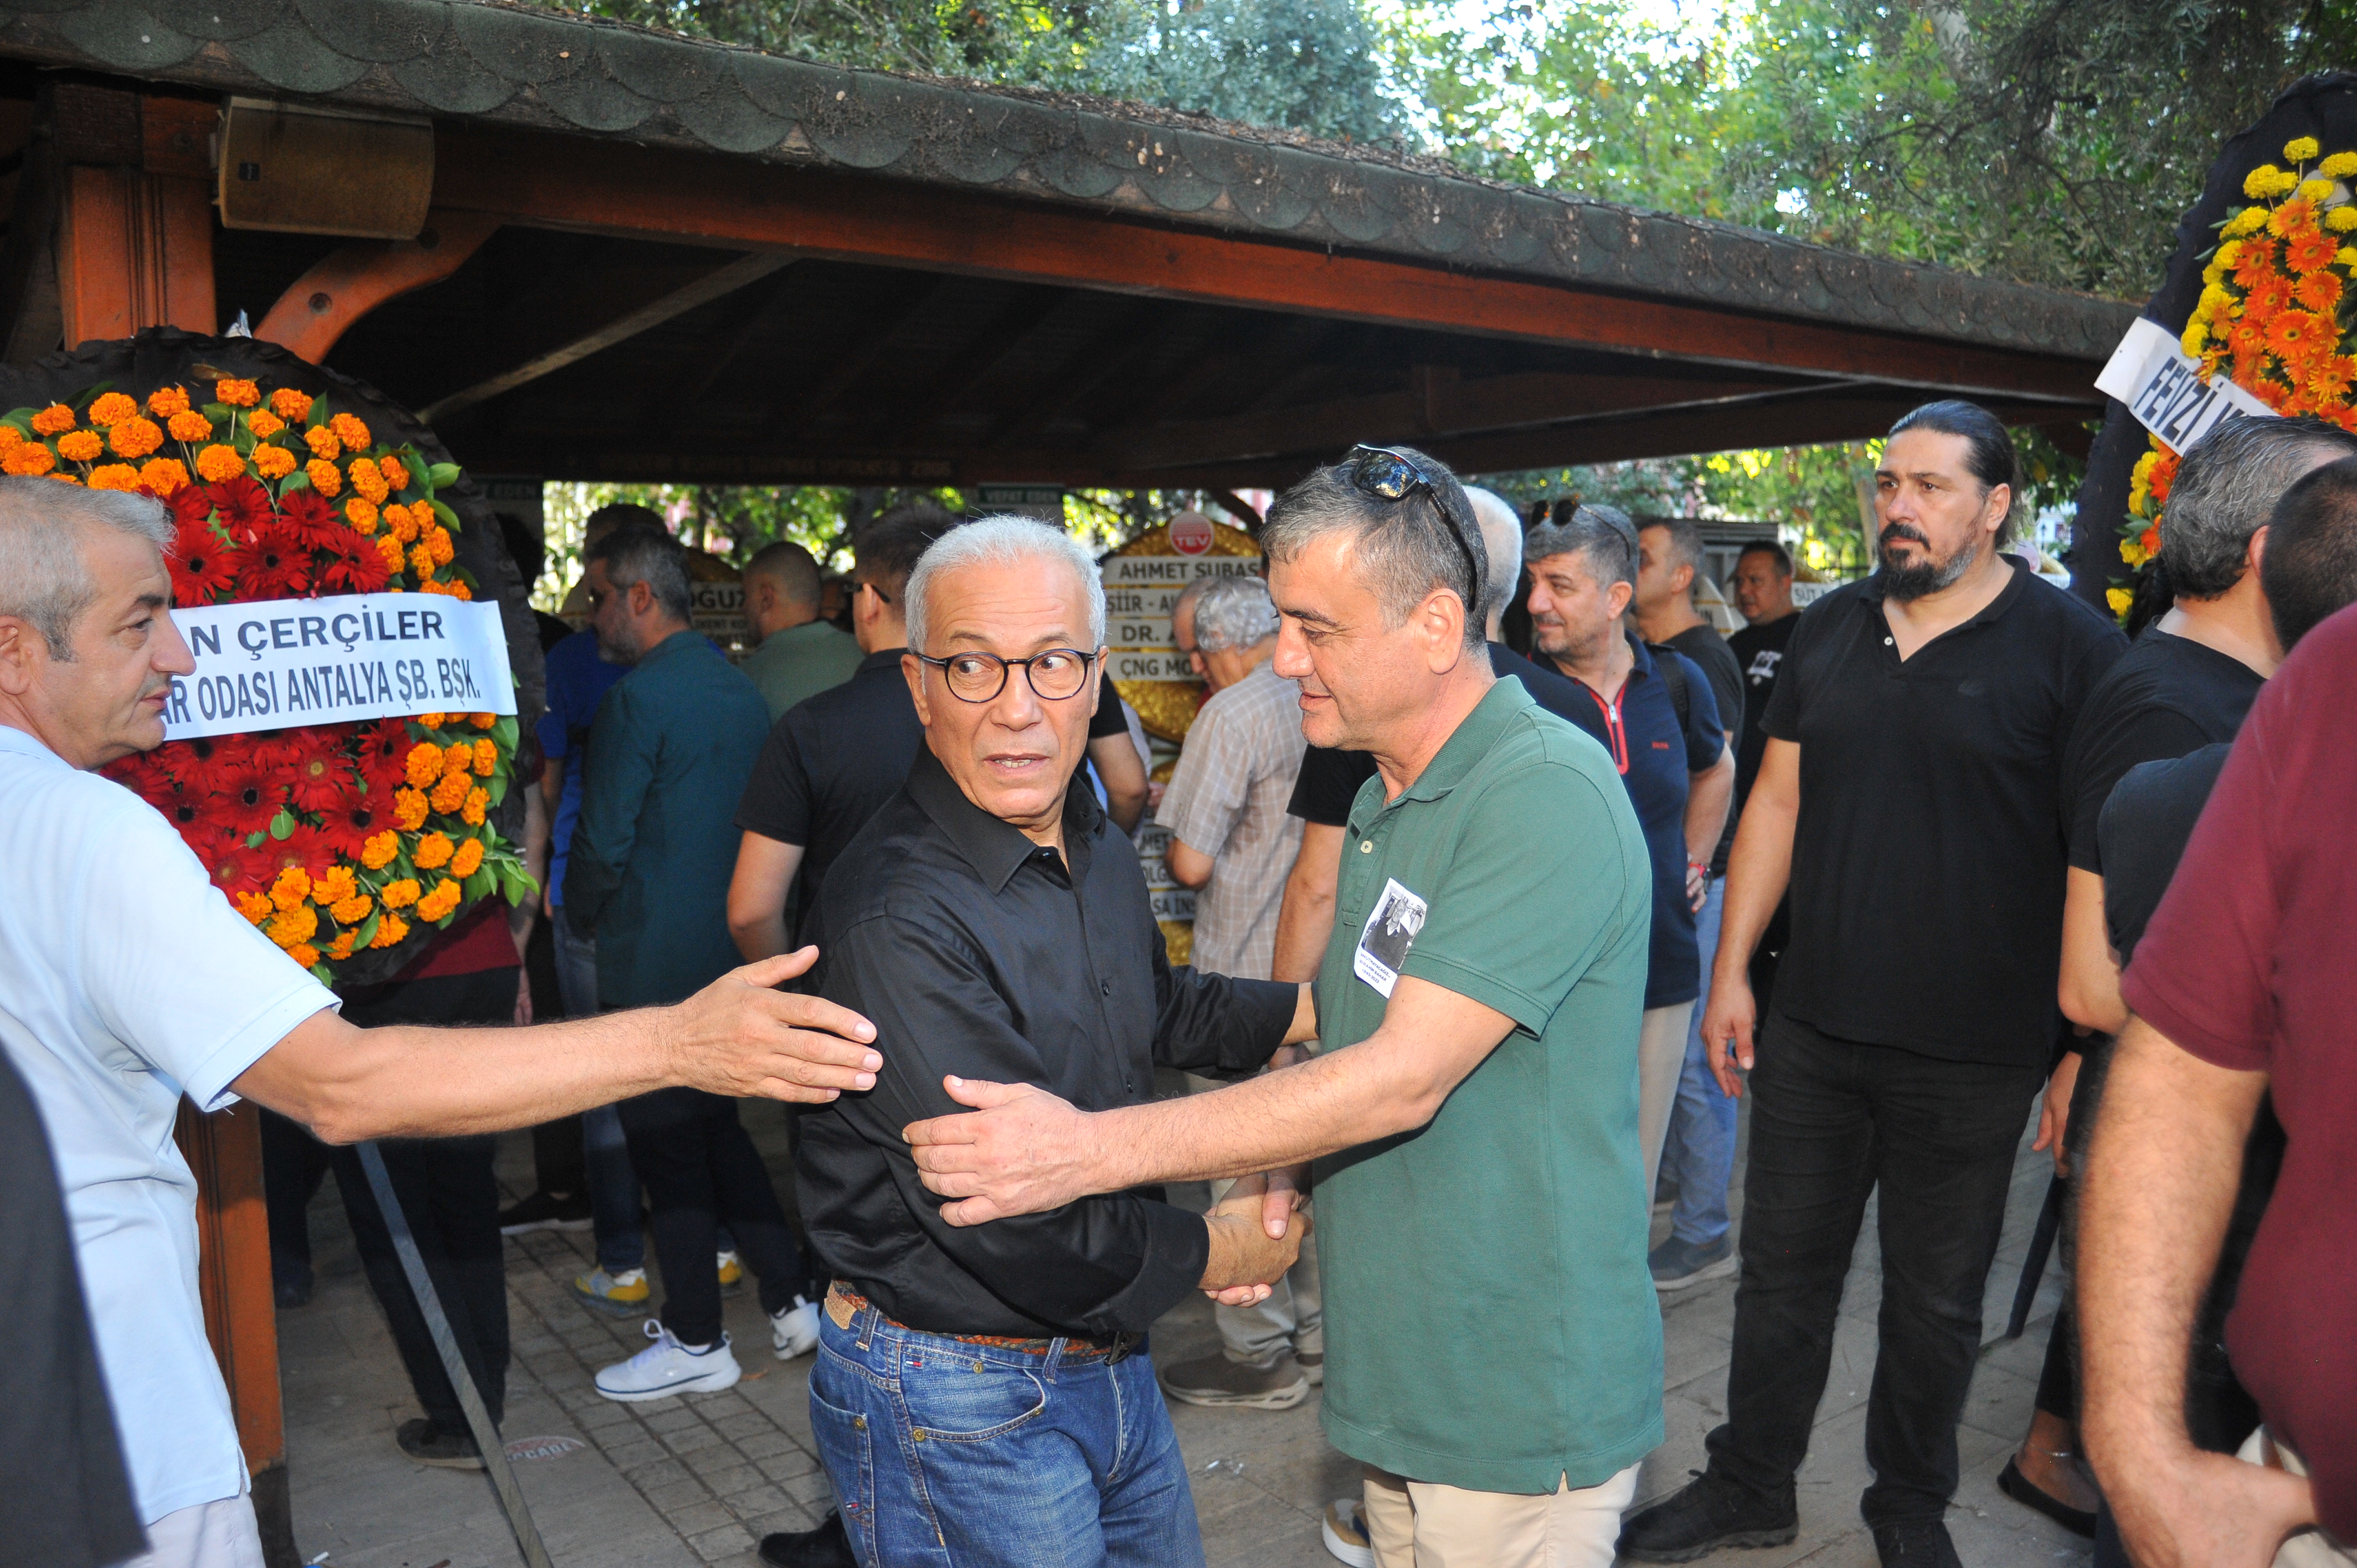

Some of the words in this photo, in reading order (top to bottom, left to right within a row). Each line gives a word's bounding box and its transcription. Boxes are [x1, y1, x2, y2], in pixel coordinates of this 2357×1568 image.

[2134, 355, 2225, 447] FEVZİ
[1175, 535, 1209, 547] TEV
[1119, 562, 1190, 579] AHMET
[238, 604, 445, 661] ÇERÇİLER
[1121, 625, 1160, 642] DR.
[198, 670, 280, 720] ODASI
[288, 661, 394, 712] ANTALYA
[395, 659, 436, 710] ŞB.
[436, 658, 481, 707] BŞK.
